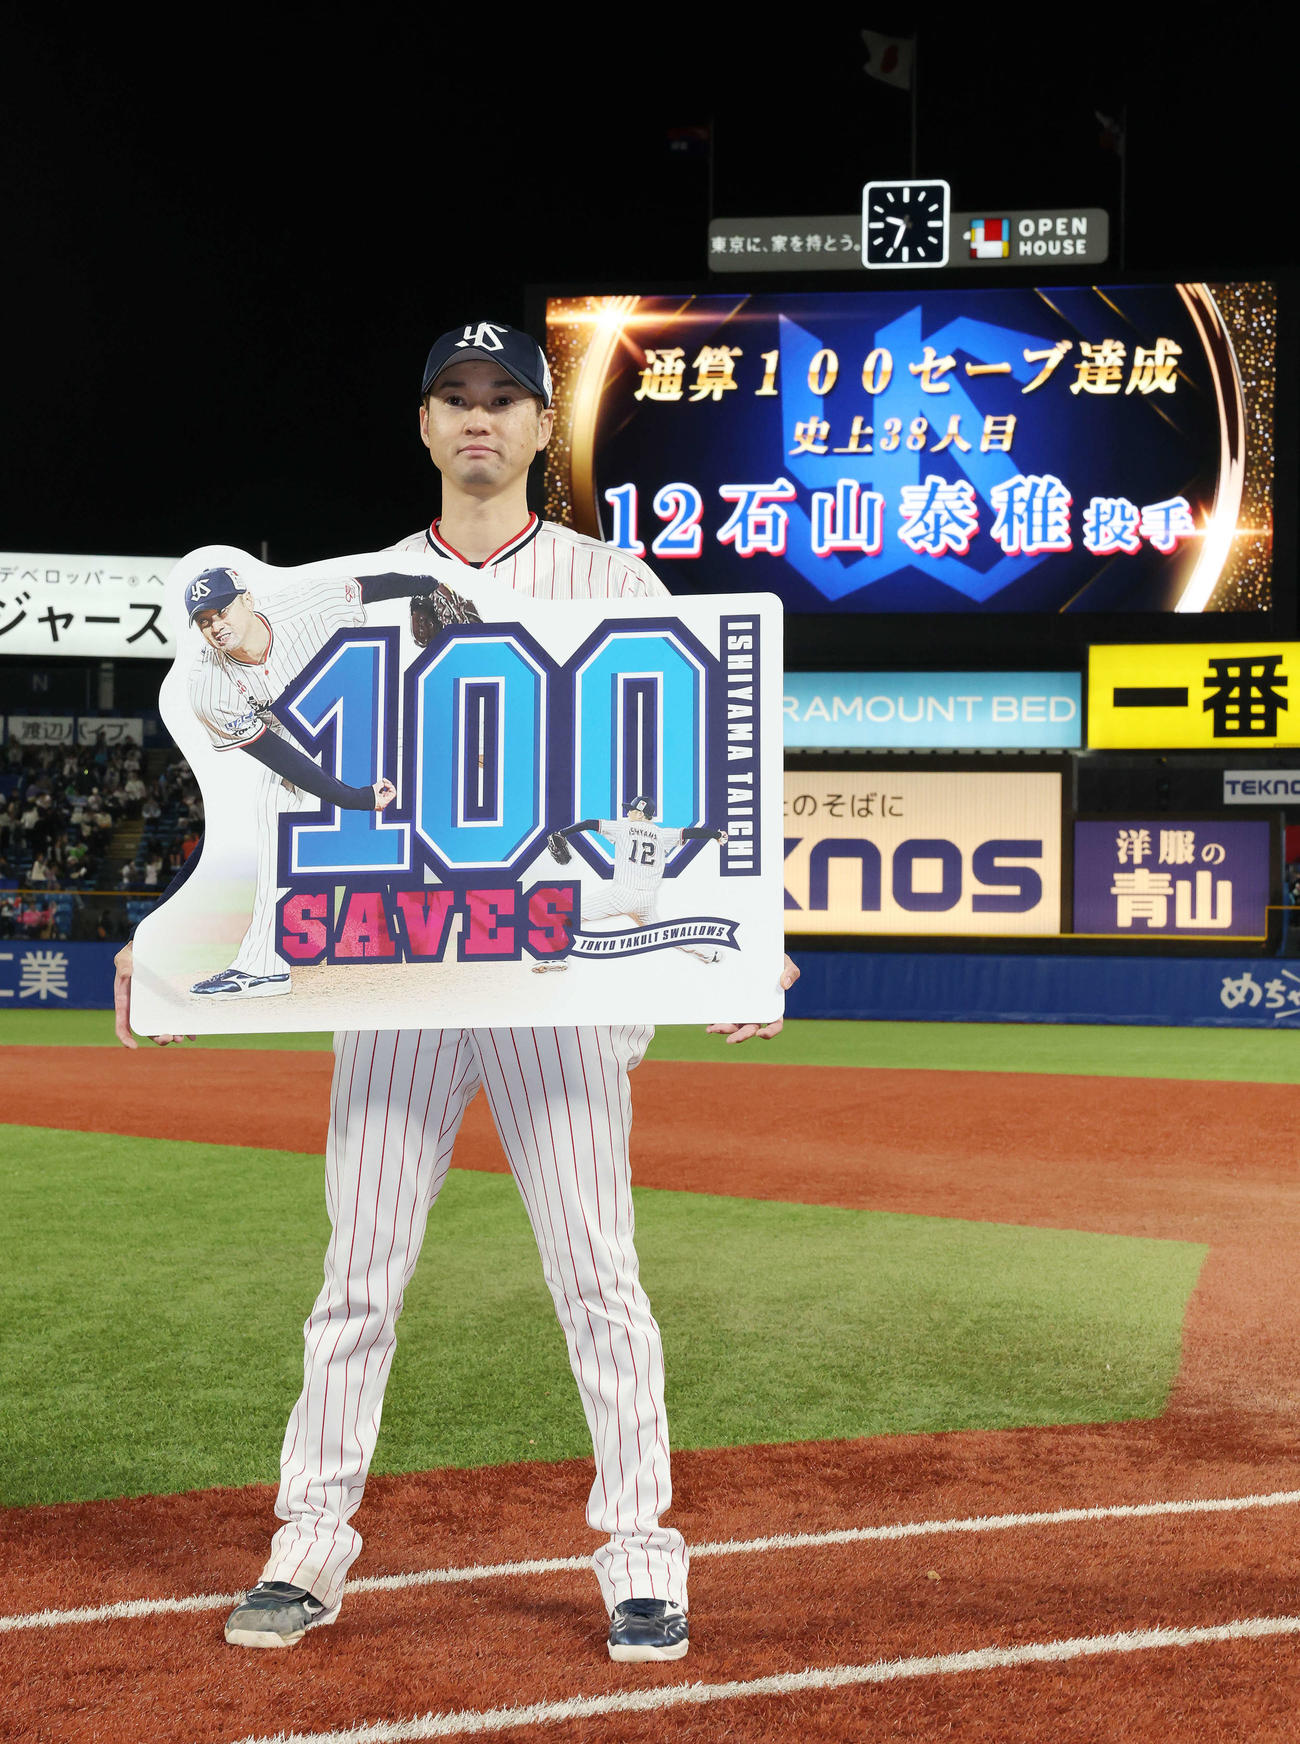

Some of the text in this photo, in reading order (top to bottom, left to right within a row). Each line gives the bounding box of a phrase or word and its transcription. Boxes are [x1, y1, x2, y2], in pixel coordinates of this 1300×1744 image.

[710, 234, 862, 254] 東京に、家を持とう。
[1018, 217, 1088, 237] OPEN
[1018, 239, 1087, 256] HOUSE
[788, 414, 1017, 456] 史上38人目
[0, 591, 168, 644] ジャース
[991, 695, 1077, 723] BED
[1112, 655, 1288, 738] 一番
[280, 624, 714, 878] 100
[727, 621, 754, 869] ISHIYAMA TAICHI
[784, 792, 904, 818] のそばに
[627, 839, 656, 866] 12
[1116, 828, 1226, 865] 洋服の
[1110, 868, 1233, 929] 青山
[278, 884, 578, 963] SAVES
[580, 925, 725, 951] TOKYO YAKULT SWALLOWS
